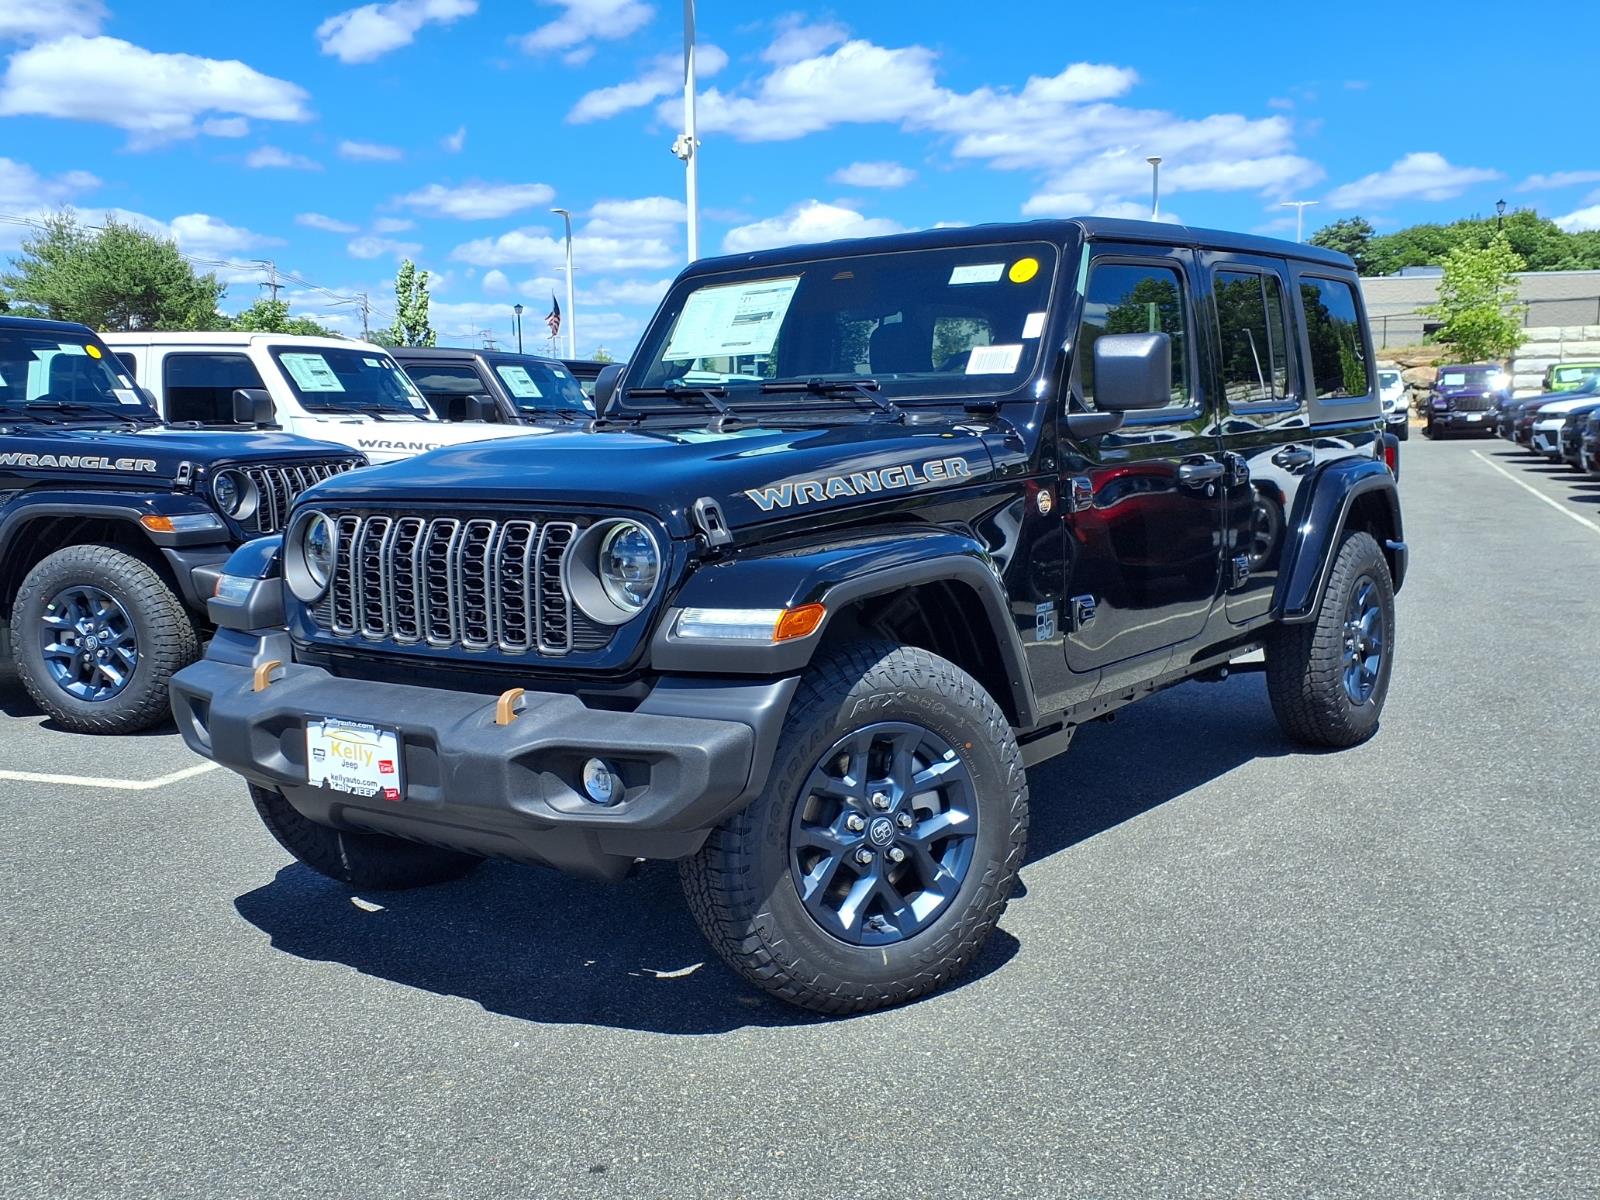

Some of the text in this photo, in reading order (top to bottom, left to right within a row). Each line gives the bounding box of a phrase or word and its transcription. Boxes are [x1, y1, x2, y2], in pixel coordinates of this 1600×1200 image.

[0, 452, 157, 473] WRANGLER
[745, 457, 971, 511] WRANGLER
[331, 741, 374, 767] Kelly
[341, 759, 359, 771] Jeep
[330, 773, 378, 788] kellyauto.com
[330, 782, 352, 794] Kelly
[352, 787, 377, 798] JEEP
